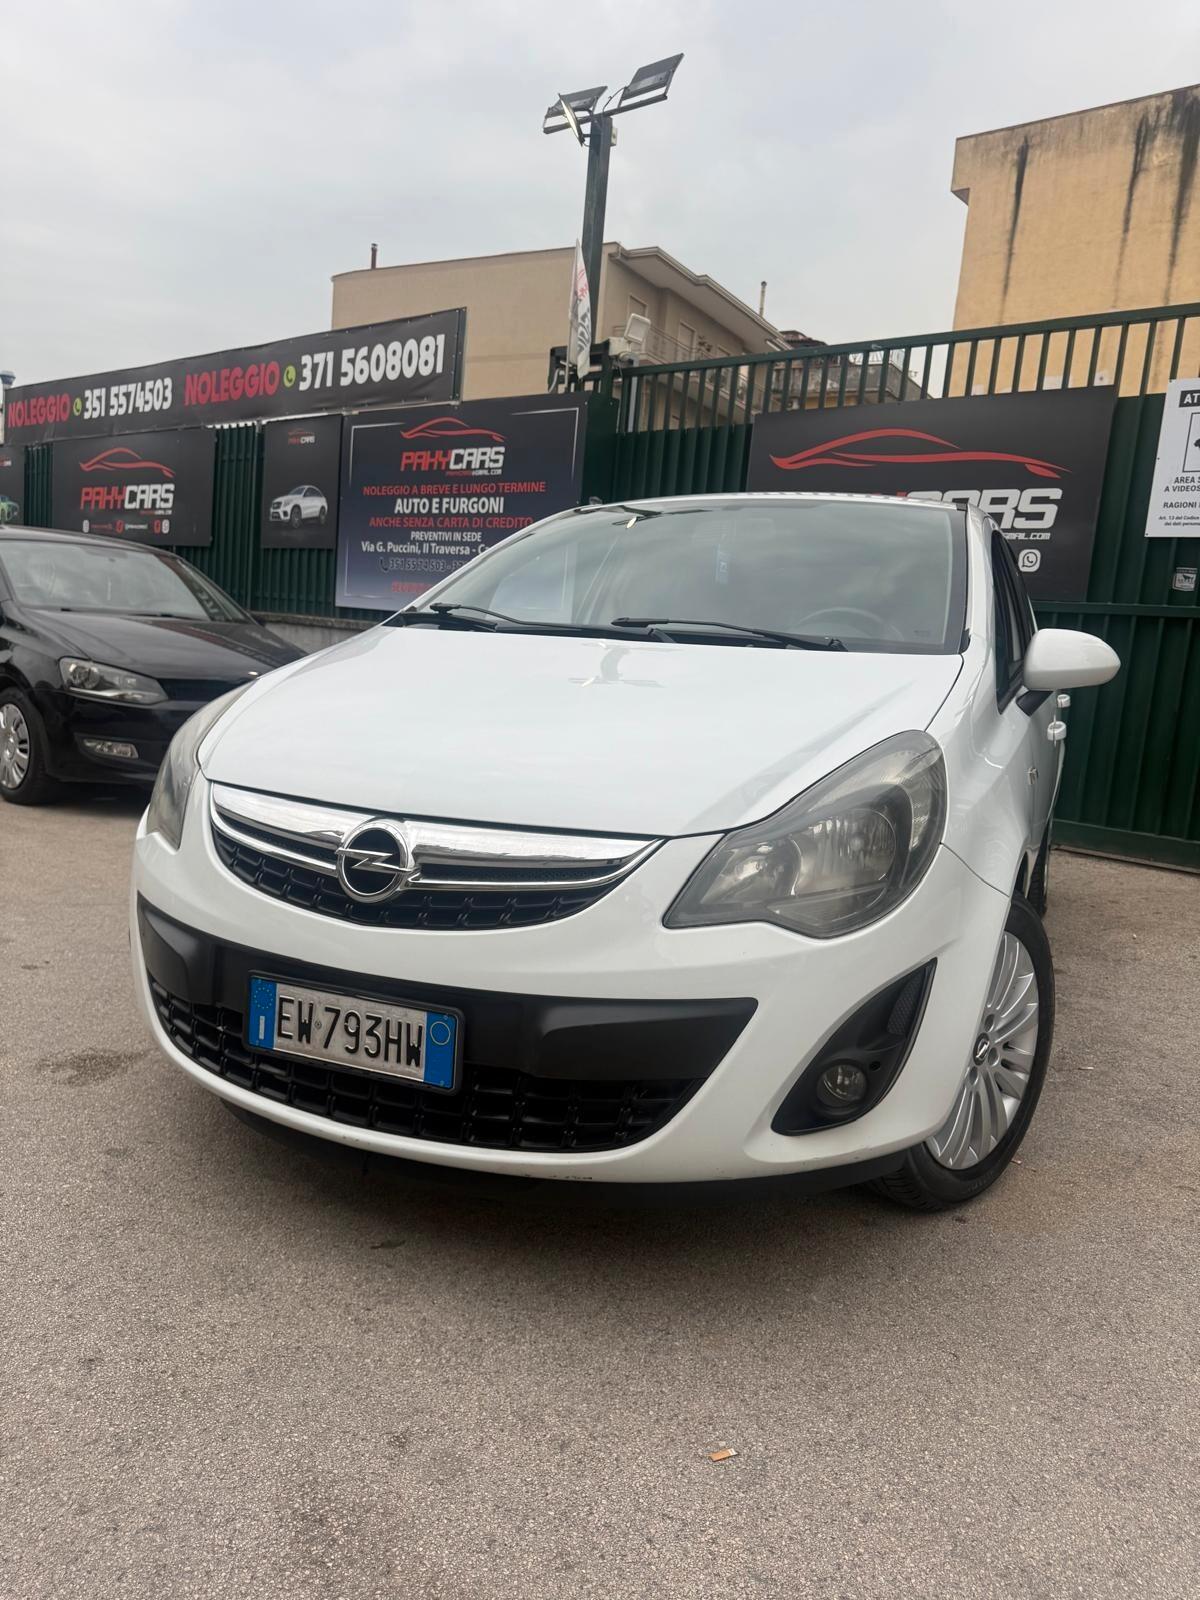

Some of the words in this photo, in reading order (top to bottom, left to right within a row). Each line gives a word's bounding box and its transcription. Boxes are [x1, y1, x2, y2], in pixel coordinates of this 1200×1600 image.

[8, 393, 70, 428] NOLEGGIO
[83, 389, 105, 419] 351
[109, 377, 173, 416] 5574503
[184, 361, 281, 406] NOLEGGIO
[299, 351, 334, 391] 371
[340, 334, 446, 386] 5608081
[1174, 476, 1195, 484] AREA
[363, 485, 410, 496] NOLEGGIO
[411, 485, 419, 495] A
[420, 484, 450, 495] BREVE
[452, 484, 459, 494] E
[460, 483, 496, 494] LUNGO
[498, 482, 546, 493] TERMINE
[394, 498, 429, 514] AUTO
[432, 498, 439, 513] E
[442, 497, 504, 514] FURGONI
[369, 517, 401, 528] ANCHE
[403, 517, 434, 528] SENZA
[436, 517, 469, 528] CARTA
[472, 517, 484, 528] DI
[486, 517, 533, 528] CREDITO
[410, 531, 453, 542] PREVENTIVI
[453, 531, 461, 542] IN
[462, 531, 482, 542] SEDE
[361, 541, 375, 552] Via
[376, 541, 386, 552] G.
[387, 542, 421, 554] Puccini,
[430, 543, 470, 555] Traversa
